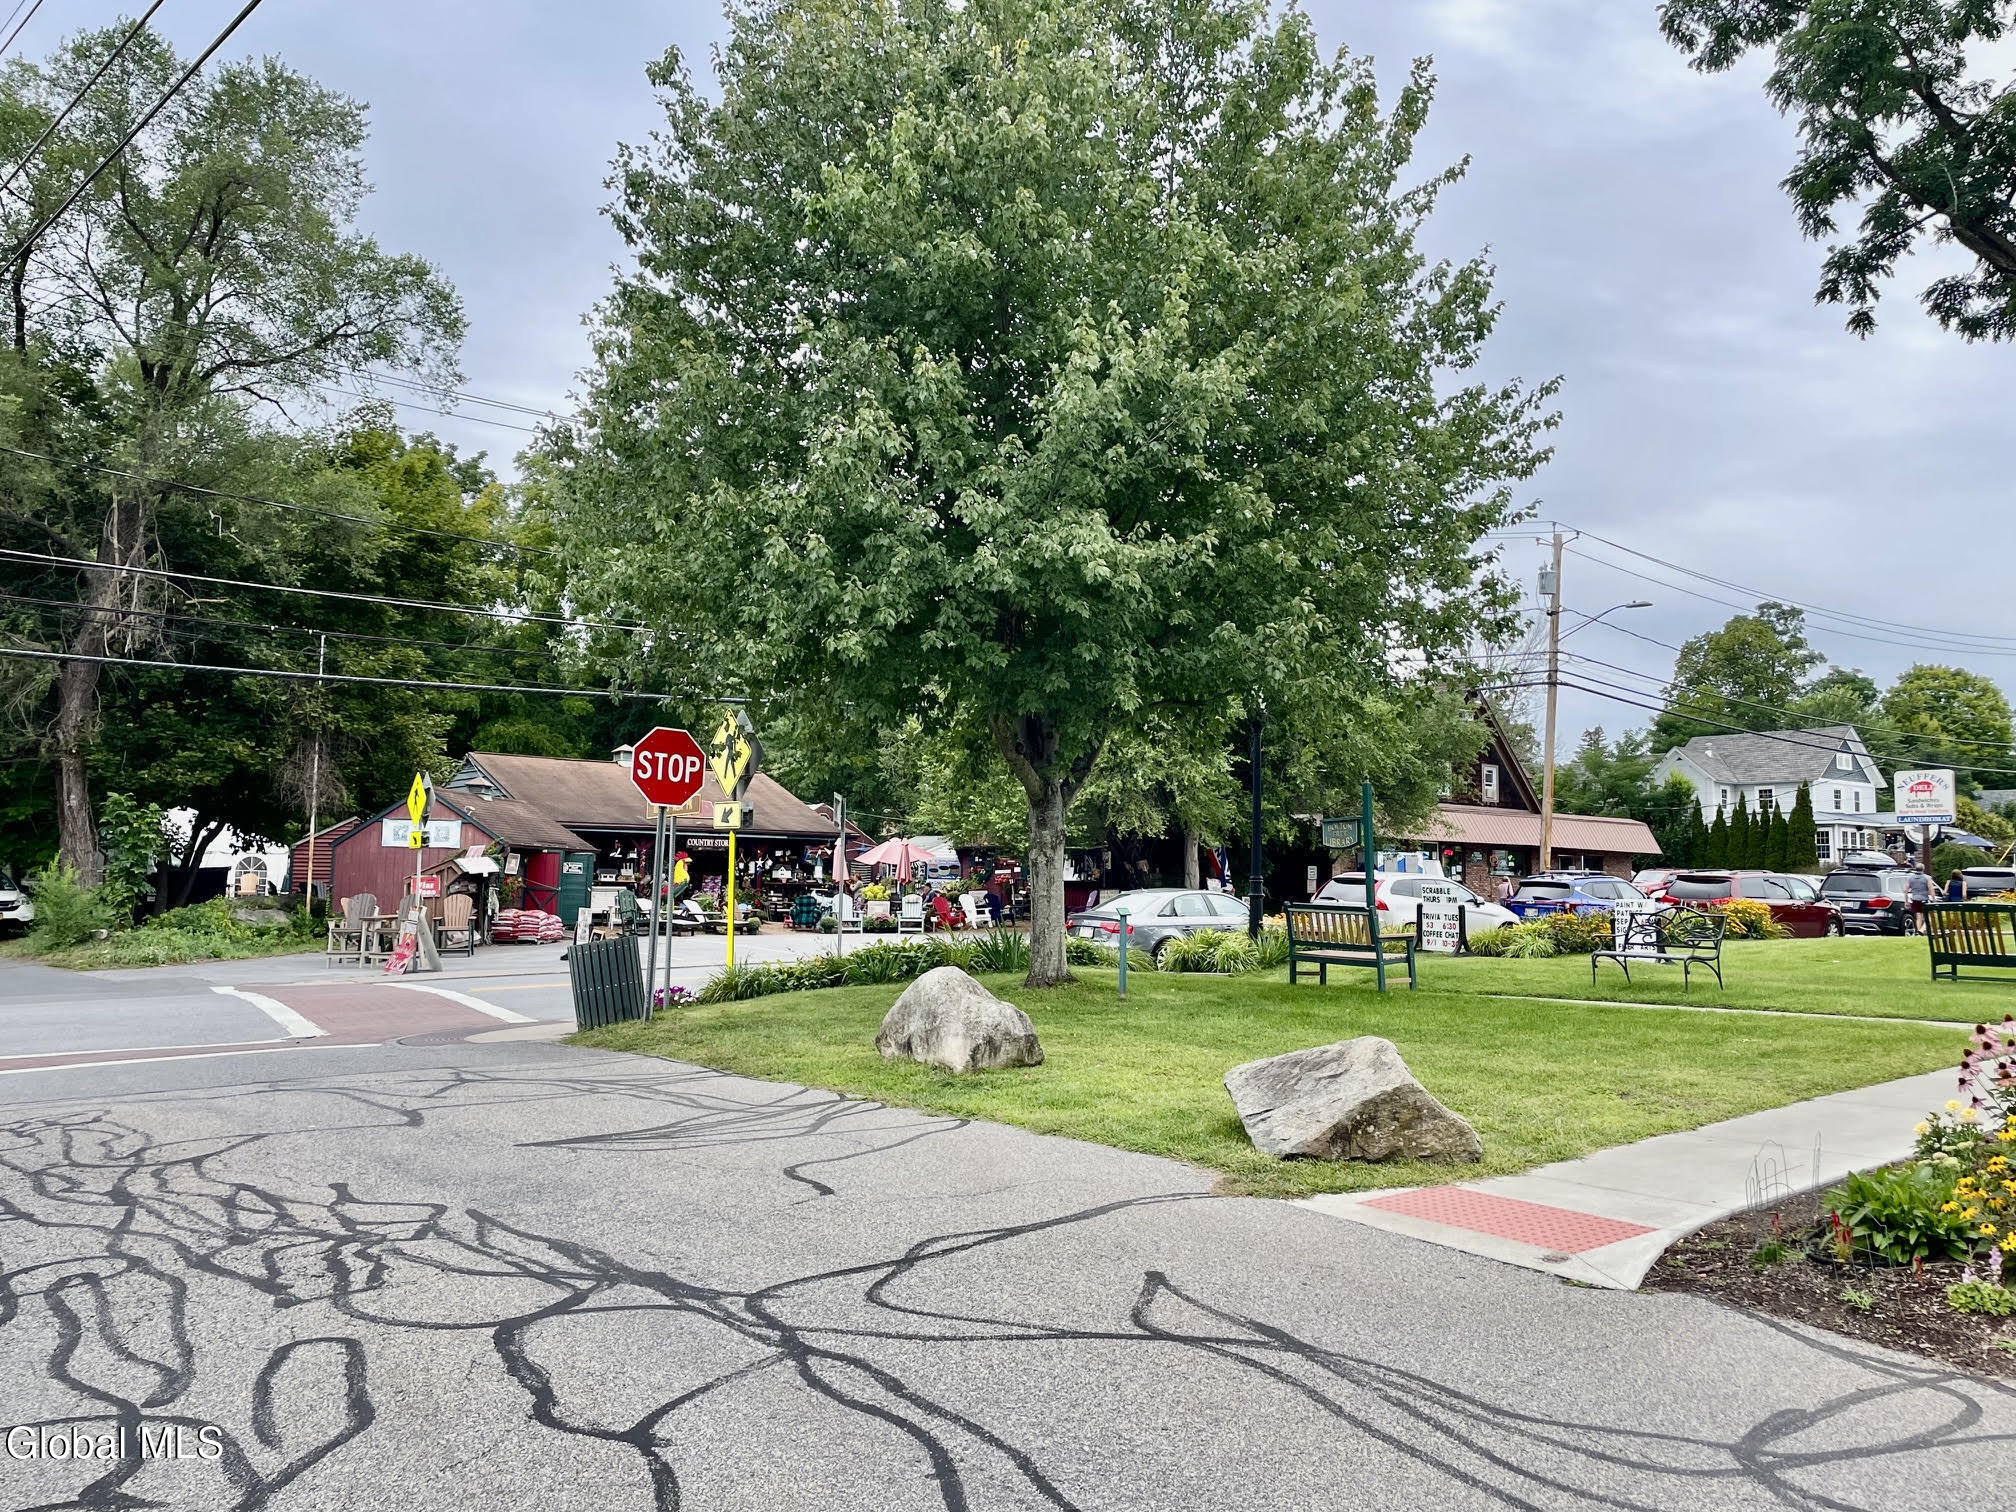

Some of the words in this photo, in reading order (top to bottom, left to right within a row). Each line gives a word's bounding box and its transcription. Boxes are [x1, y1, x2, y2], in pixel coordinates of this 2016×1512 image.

[637, 750, 700, 783] STOP
[687, 838, 714, 847] COUNTRY
[714, 839, 729, 847] STOR
[1326, 837, 1353, 847] LIBRARY
[1422, 887, 1451, 895] SCRABBLE
[1446, 896, 1458, 904] 1PM
[1442, 922, 1457, 930] 6:30
[1422, 930, 1443, 938] COFFEE
[1444, 931, 1460, 939] CHAT
